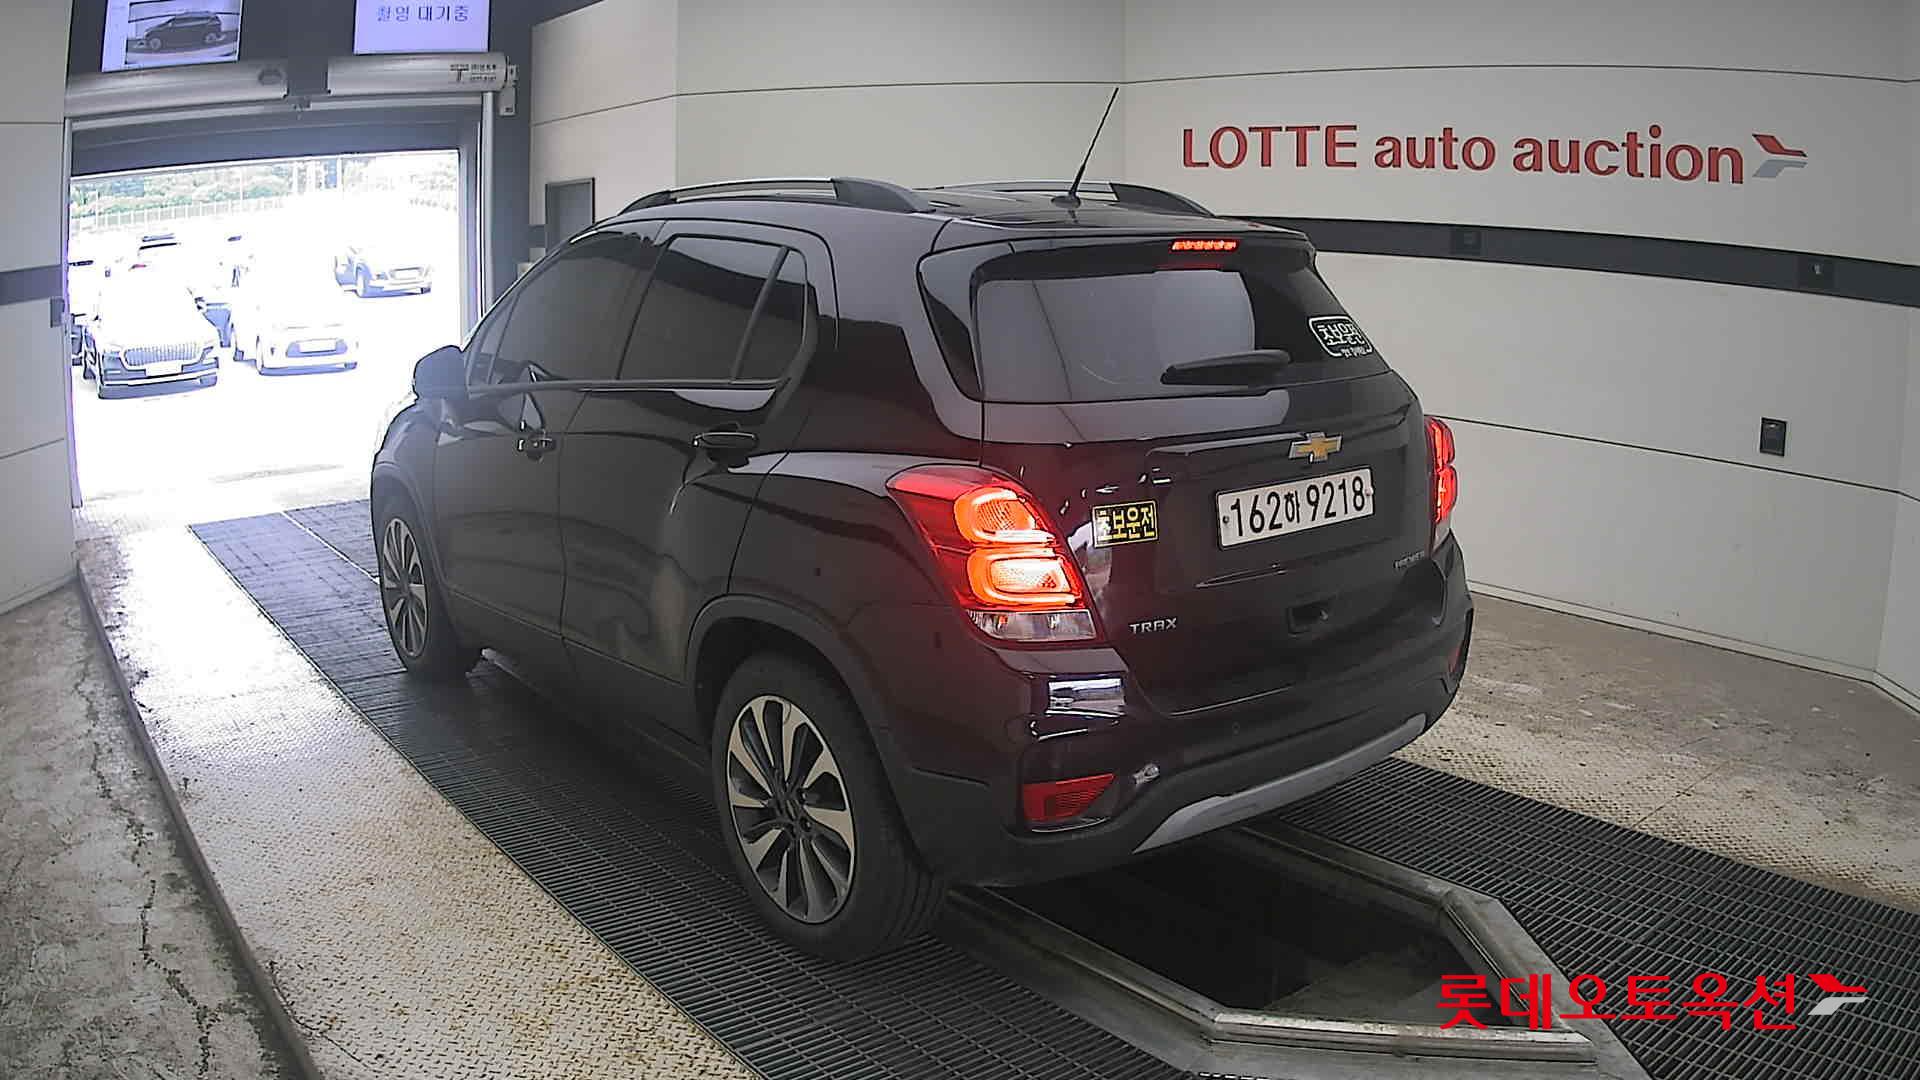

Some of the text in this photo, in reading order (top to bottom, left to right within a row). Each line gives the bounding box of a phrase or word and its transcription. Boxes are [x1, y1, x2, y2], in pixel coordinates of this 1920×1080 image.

[417, 5, 469, 22] 대기중
[1182, 124, 1744, 185] LOTTE auto auction
[1096, 504, 1156, 541] 초보운전
[1231, 475, 1365, 537] 162하 9218
[1129, 617, 1178, 635] TRAX
